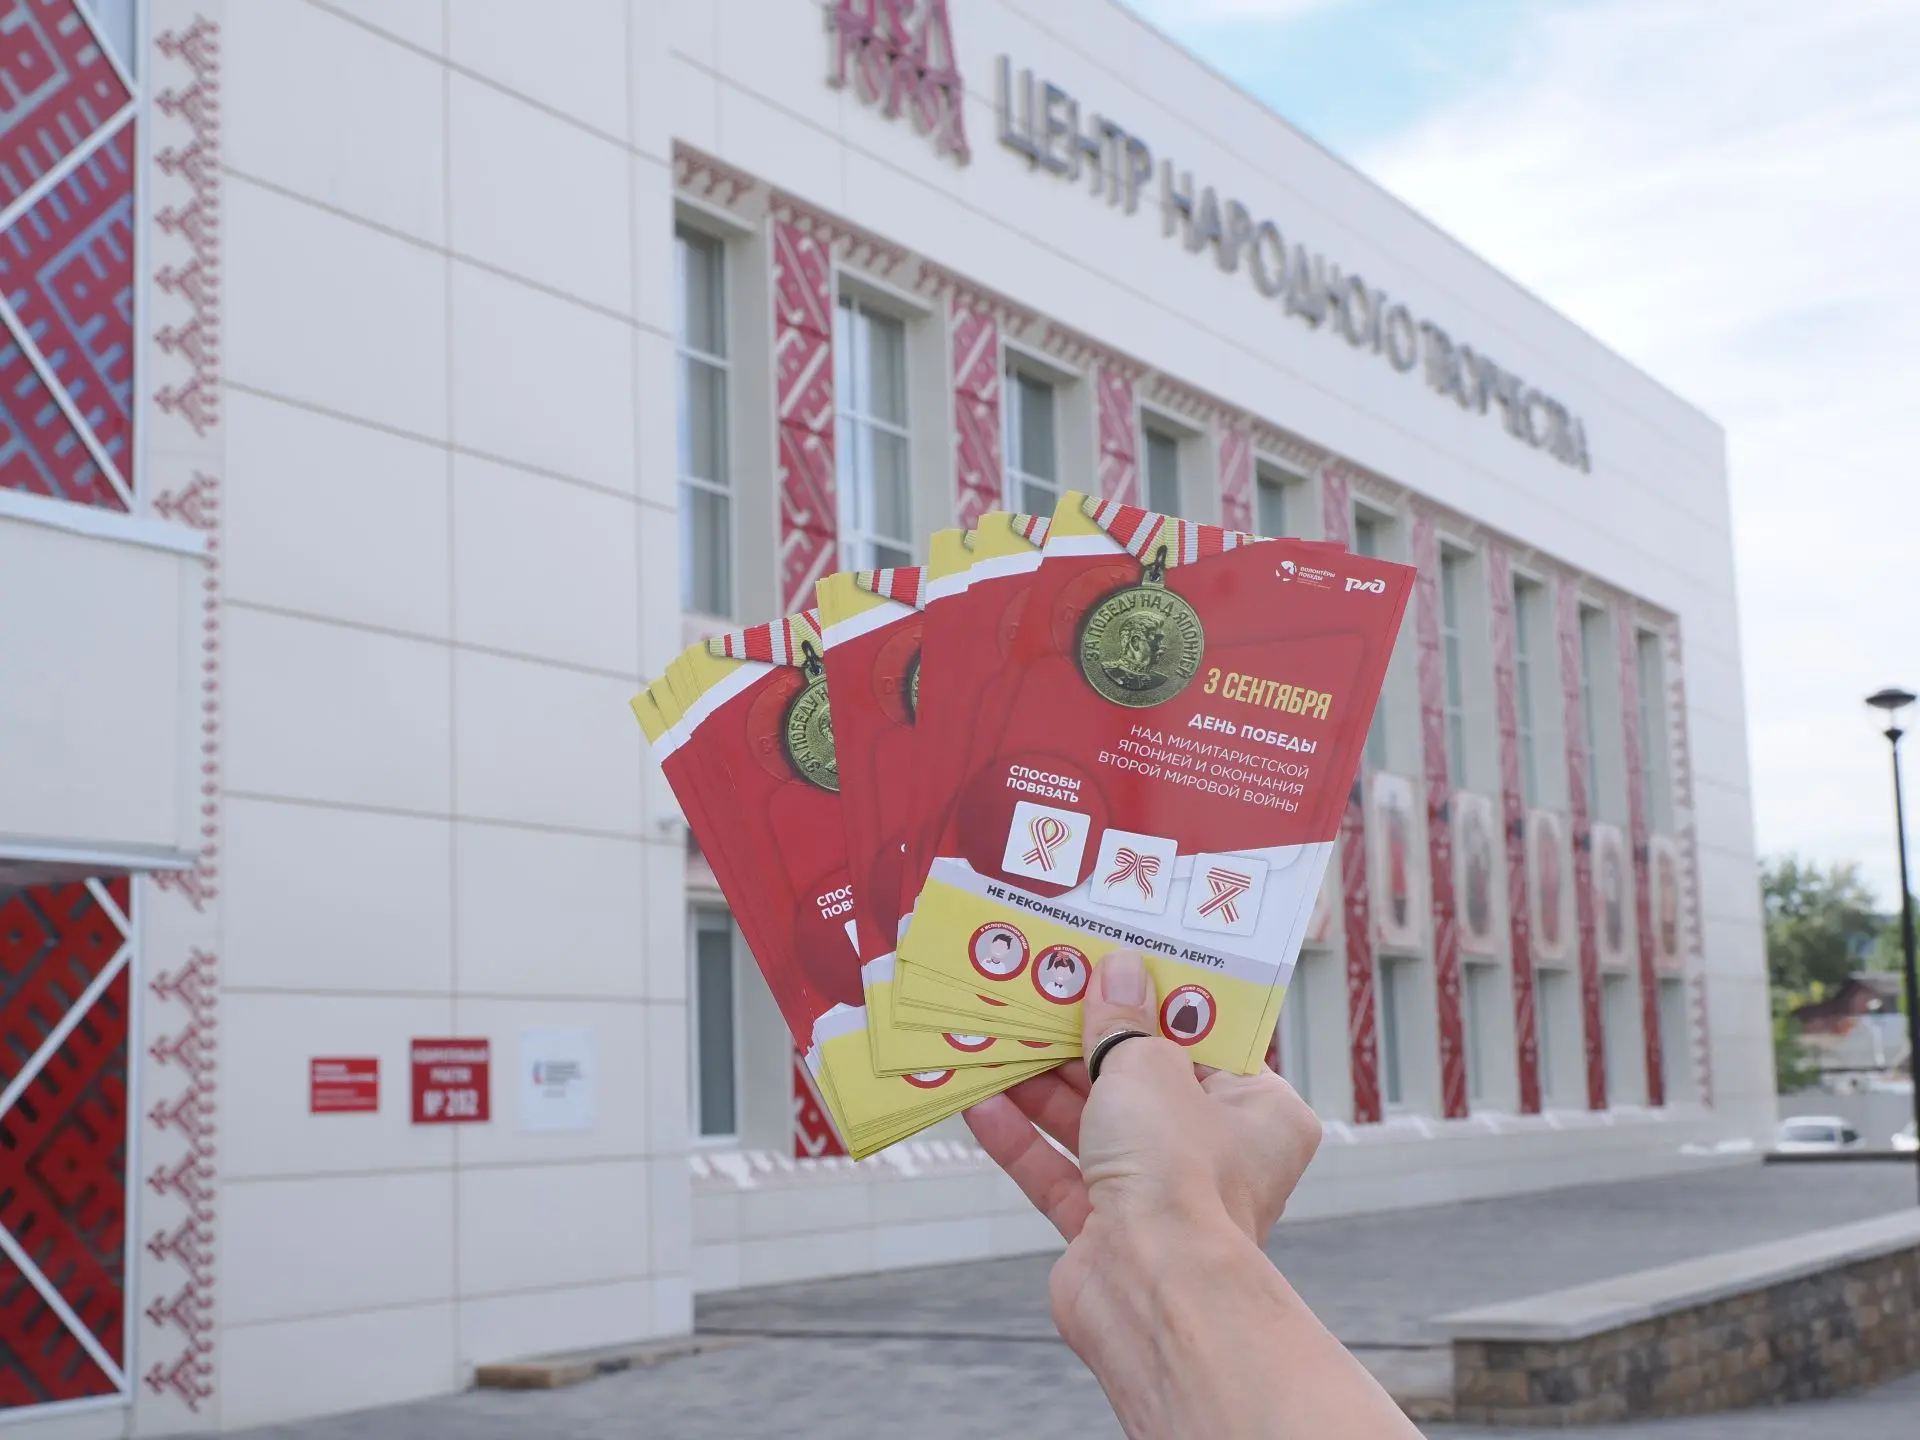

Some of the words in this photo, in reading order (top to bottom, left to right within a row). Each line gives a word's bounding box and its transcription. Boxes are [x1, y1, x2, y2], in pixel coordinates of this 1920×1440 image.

[995, 54, 1153, 216] ЦЕНТР
[1160, 157, 1417, 373] НАРОДНОГО
[1419, 319, 1591, 475] ТВОРЧЕСТВА
[1088, 593, 1137, 639] ПОБЕДУ
[1140, 593, 1175, 618] НАД
[1084, 640, 1100, 662] ЗА
[1203, 668, 1221, 695] 3
[1222, 672, 1333, 721] СЕНТЯБРЯ
[790, 693, 819, 751] ПОБЕДУ
[1188, 713, 1237, 736] ДЕНЬ
[1240, 725, 1318, 754] ПОБЕДЫ
[1118, 738, 1192, 769] ЯПОНИЕЙ
[1194, 759, 1207, 773] И
[1210, 764, 1304, 797] ОКОНЧАНИЯ
[1130, 724, 1164, 746] НАД
[1167, 734, 1310, 780] МИЛИТАРИСТСКОЙ
[1006, 777, 1080, 803] ПОВЯЗАТЬ
[1009, 764, 1081, 790] СПОСОБЫ
[1097, 750, 1162, 779] ВТОРОЙ
[1163, 770, 1241, 799] МИРОВОЙ
[1242, 789, 1299, 814] ВОЙНЫ
[821, 898, 854, 920] ПОВ
[986, 884, 1007, 900] НЕ
[1007, 892, 1123, 940] РЕКОМЕНДУЕТСЯ
[1124, 932, 1178, 957] НОСИТЬ
[1180, 946, 1226, 969] ЛЕНТУ:
